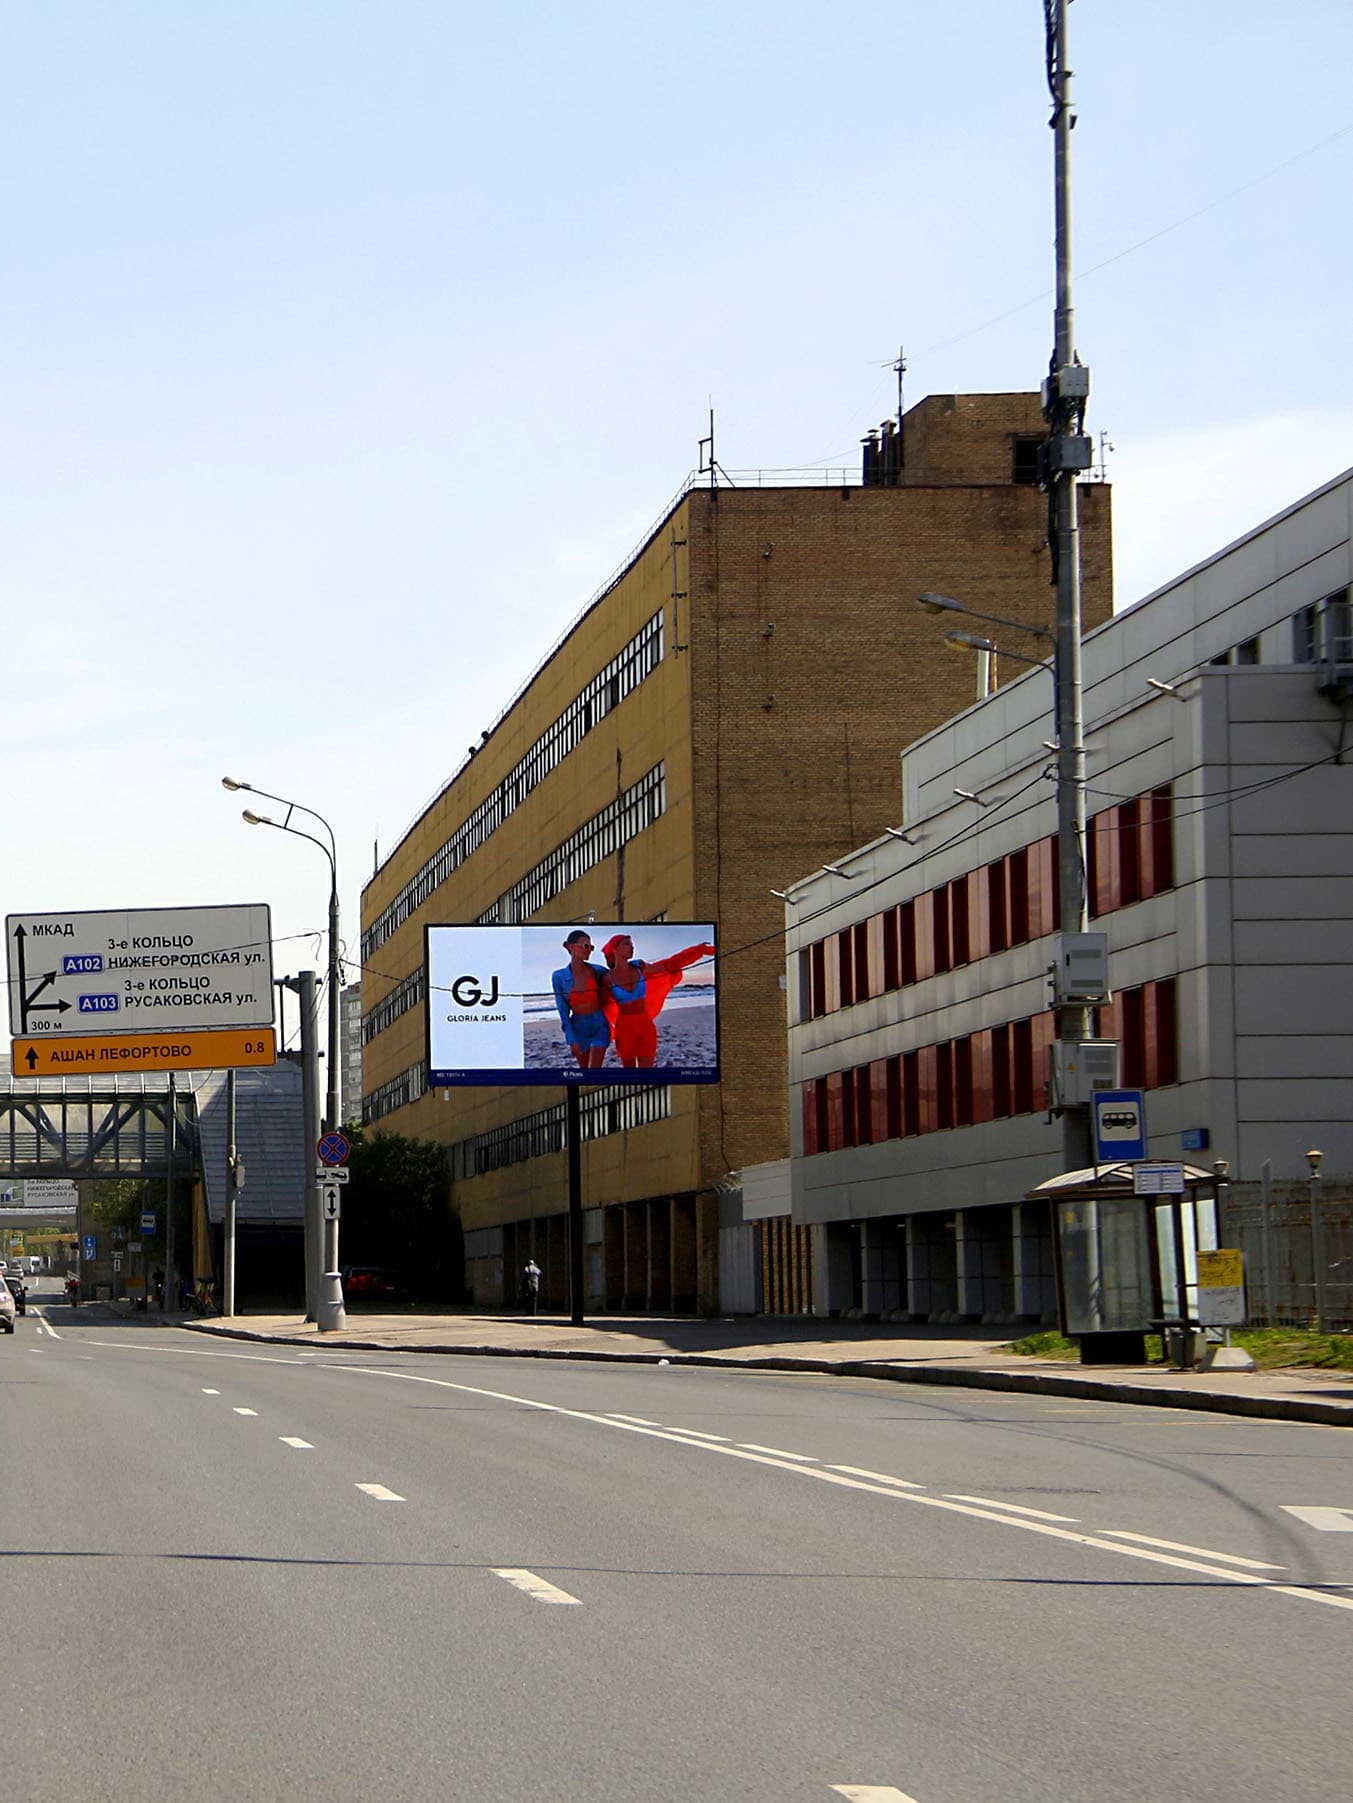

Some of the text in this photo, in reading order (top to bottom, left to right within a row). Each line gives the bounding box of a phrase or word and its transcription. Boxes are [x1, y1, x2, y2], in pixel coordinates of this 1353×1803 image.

[32, 923, 75, 937] МКАД
[108, 935, 194, 950] 3-е КОЛЬЦО
[65, 958, 100, 971] А102
[108, 952, 266, 969] НИЖЕГОРОДСКАЯ ул.
[124, 976, 210, 991] 3-е КОЛЬЦО
[452, 975, 498, 1007] GJ
[81, 997, 116, 1010] А103
[124, 992, 257, 1008] РУСАКОВСКАЯ ул.
[447, 1014, 507, 1022] GLORIA JEANS
[31, 1020, 50, 1031] 300
[50, 1045, 192, 1062] АШАН ЛЕФОРТОВО
[245, 1042, 265, 1054] 0.8
